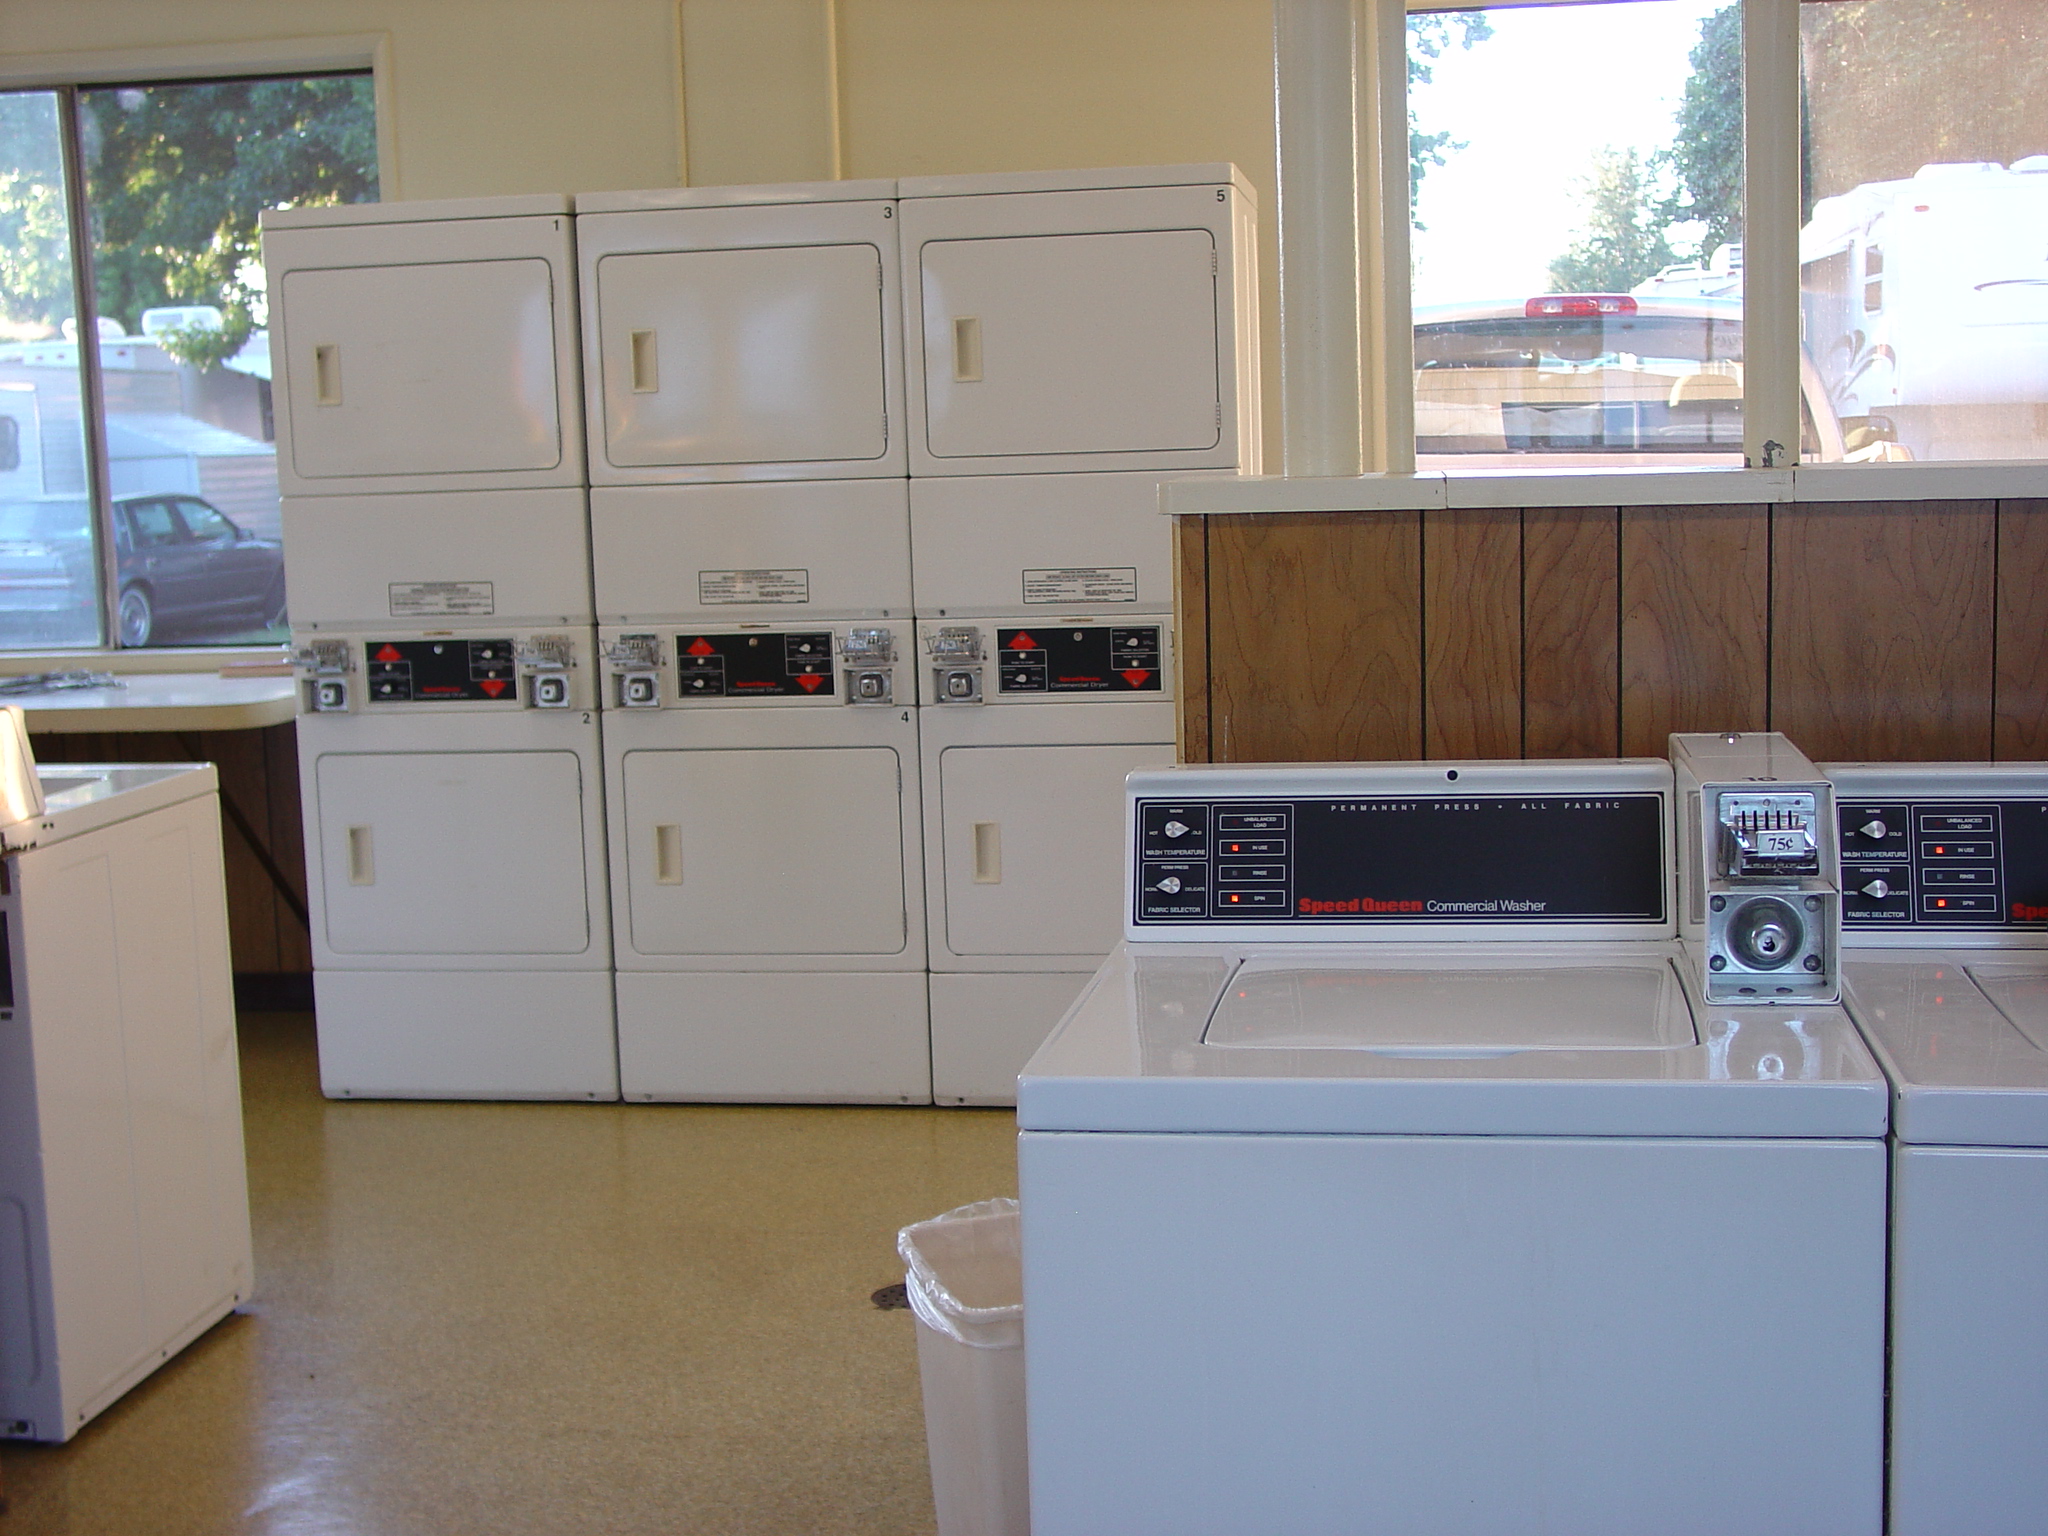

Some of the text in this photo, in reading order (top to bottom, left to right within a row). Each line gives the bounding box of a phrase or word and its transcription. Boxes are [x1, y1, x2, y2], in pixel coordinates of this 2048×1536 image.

[1217, 189, 1226, 202] 5
[884, 206, 892, 219] 3
[553, 219, 559, 231] 1
[583, 713, 591, 725] 2
[901, 711, 910, 723] 4
[1768, 837, 1793, 850] 75¢
[1299, 898, 1546, 914] Speed Queen Commercial Washer
